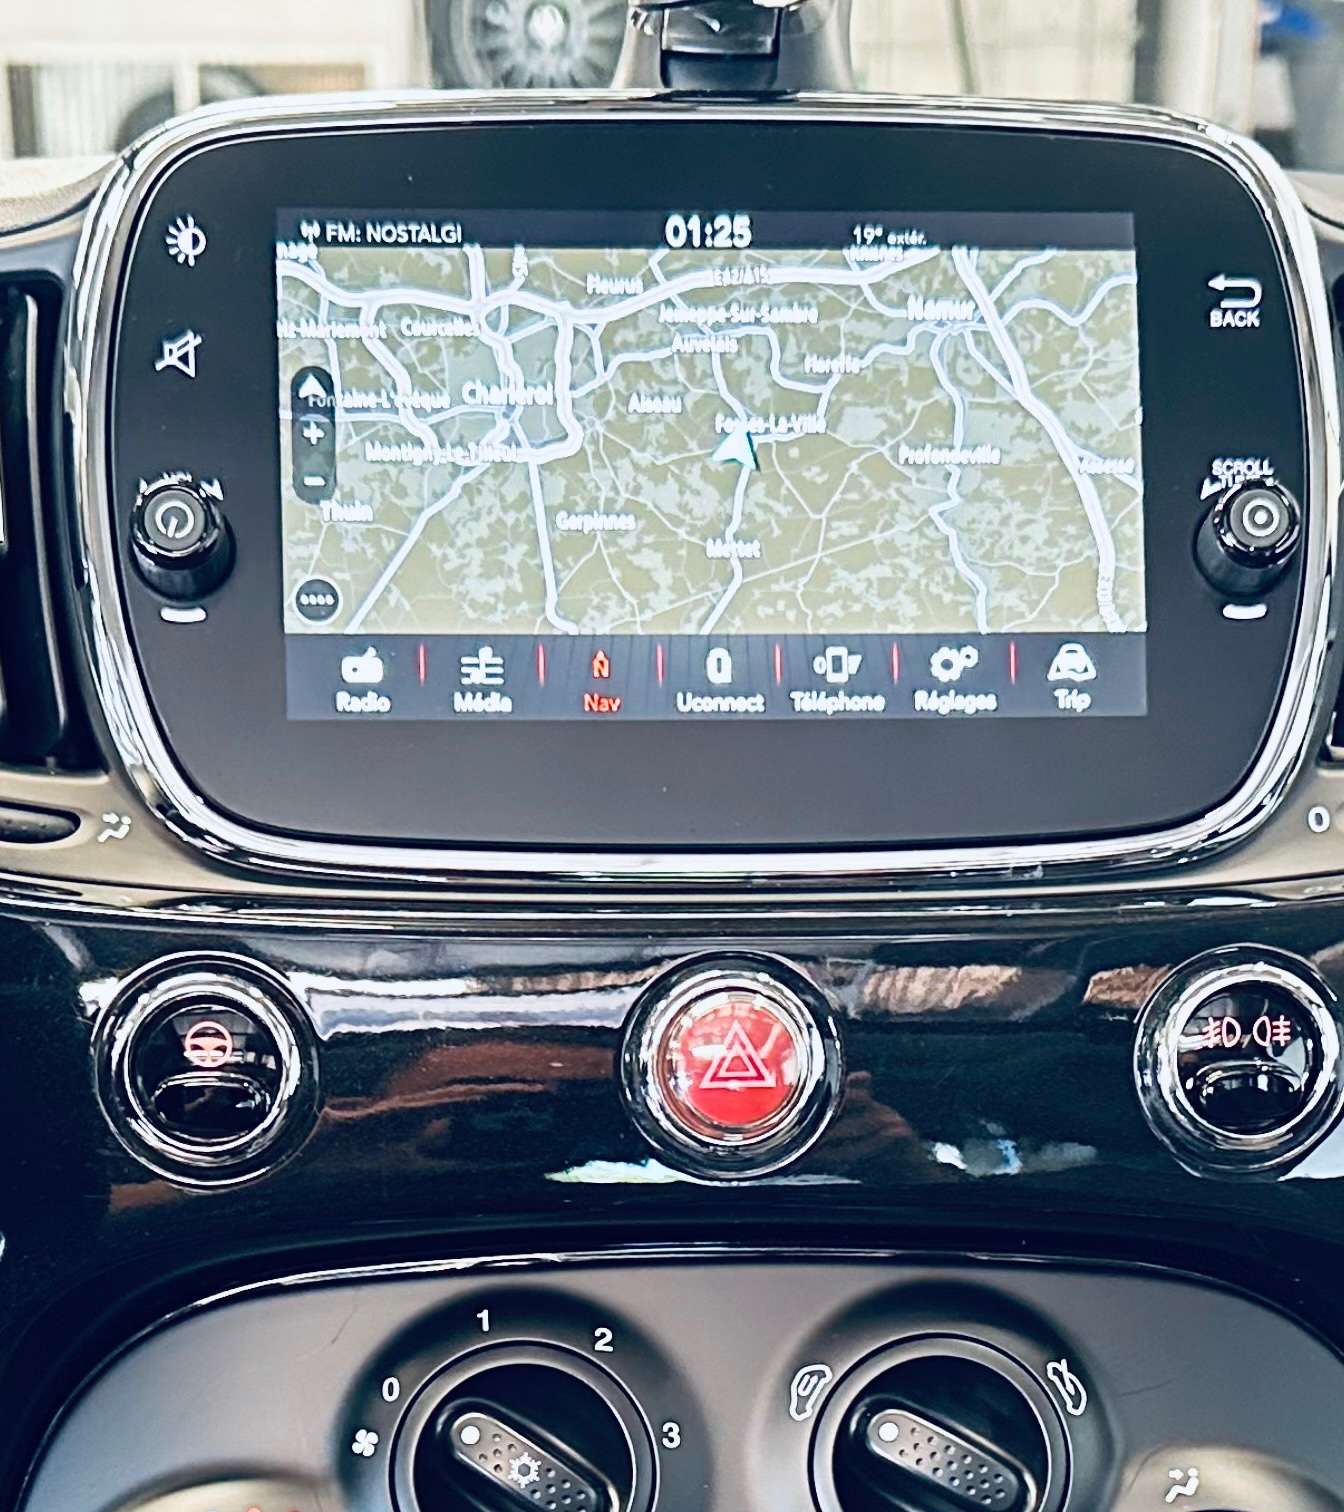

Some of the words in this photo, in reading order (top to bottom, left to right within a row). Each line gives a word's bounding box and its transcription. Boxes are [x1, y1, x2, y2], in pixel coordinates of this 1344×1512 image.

[325, 223, 361, 243] FM:
[367, 222, 462, 243] NOSTALGI
[665, 214, 752, 248] 01:25
[1209, 309, 1260, 328] BACK
[1211, 457, 1275, 476] SCROLL
[335, 690, 391, 713] Radio
[453, 690, 513, 713] Média
[584, 692, 621, 713] Nav
[676, 692, 766, 713] Uconnect
[789, 690, 886, 716] Téléphone
[913, 690, 998, 716] Réglages
[1054, 688, 1092, 712] Trip
[475, 1309, 491, 1333] 1
[593, 1327, 614, 1353] 2
[381, 1376, 400, 1402] 0
[660, 1422, 682, 1449] 3
